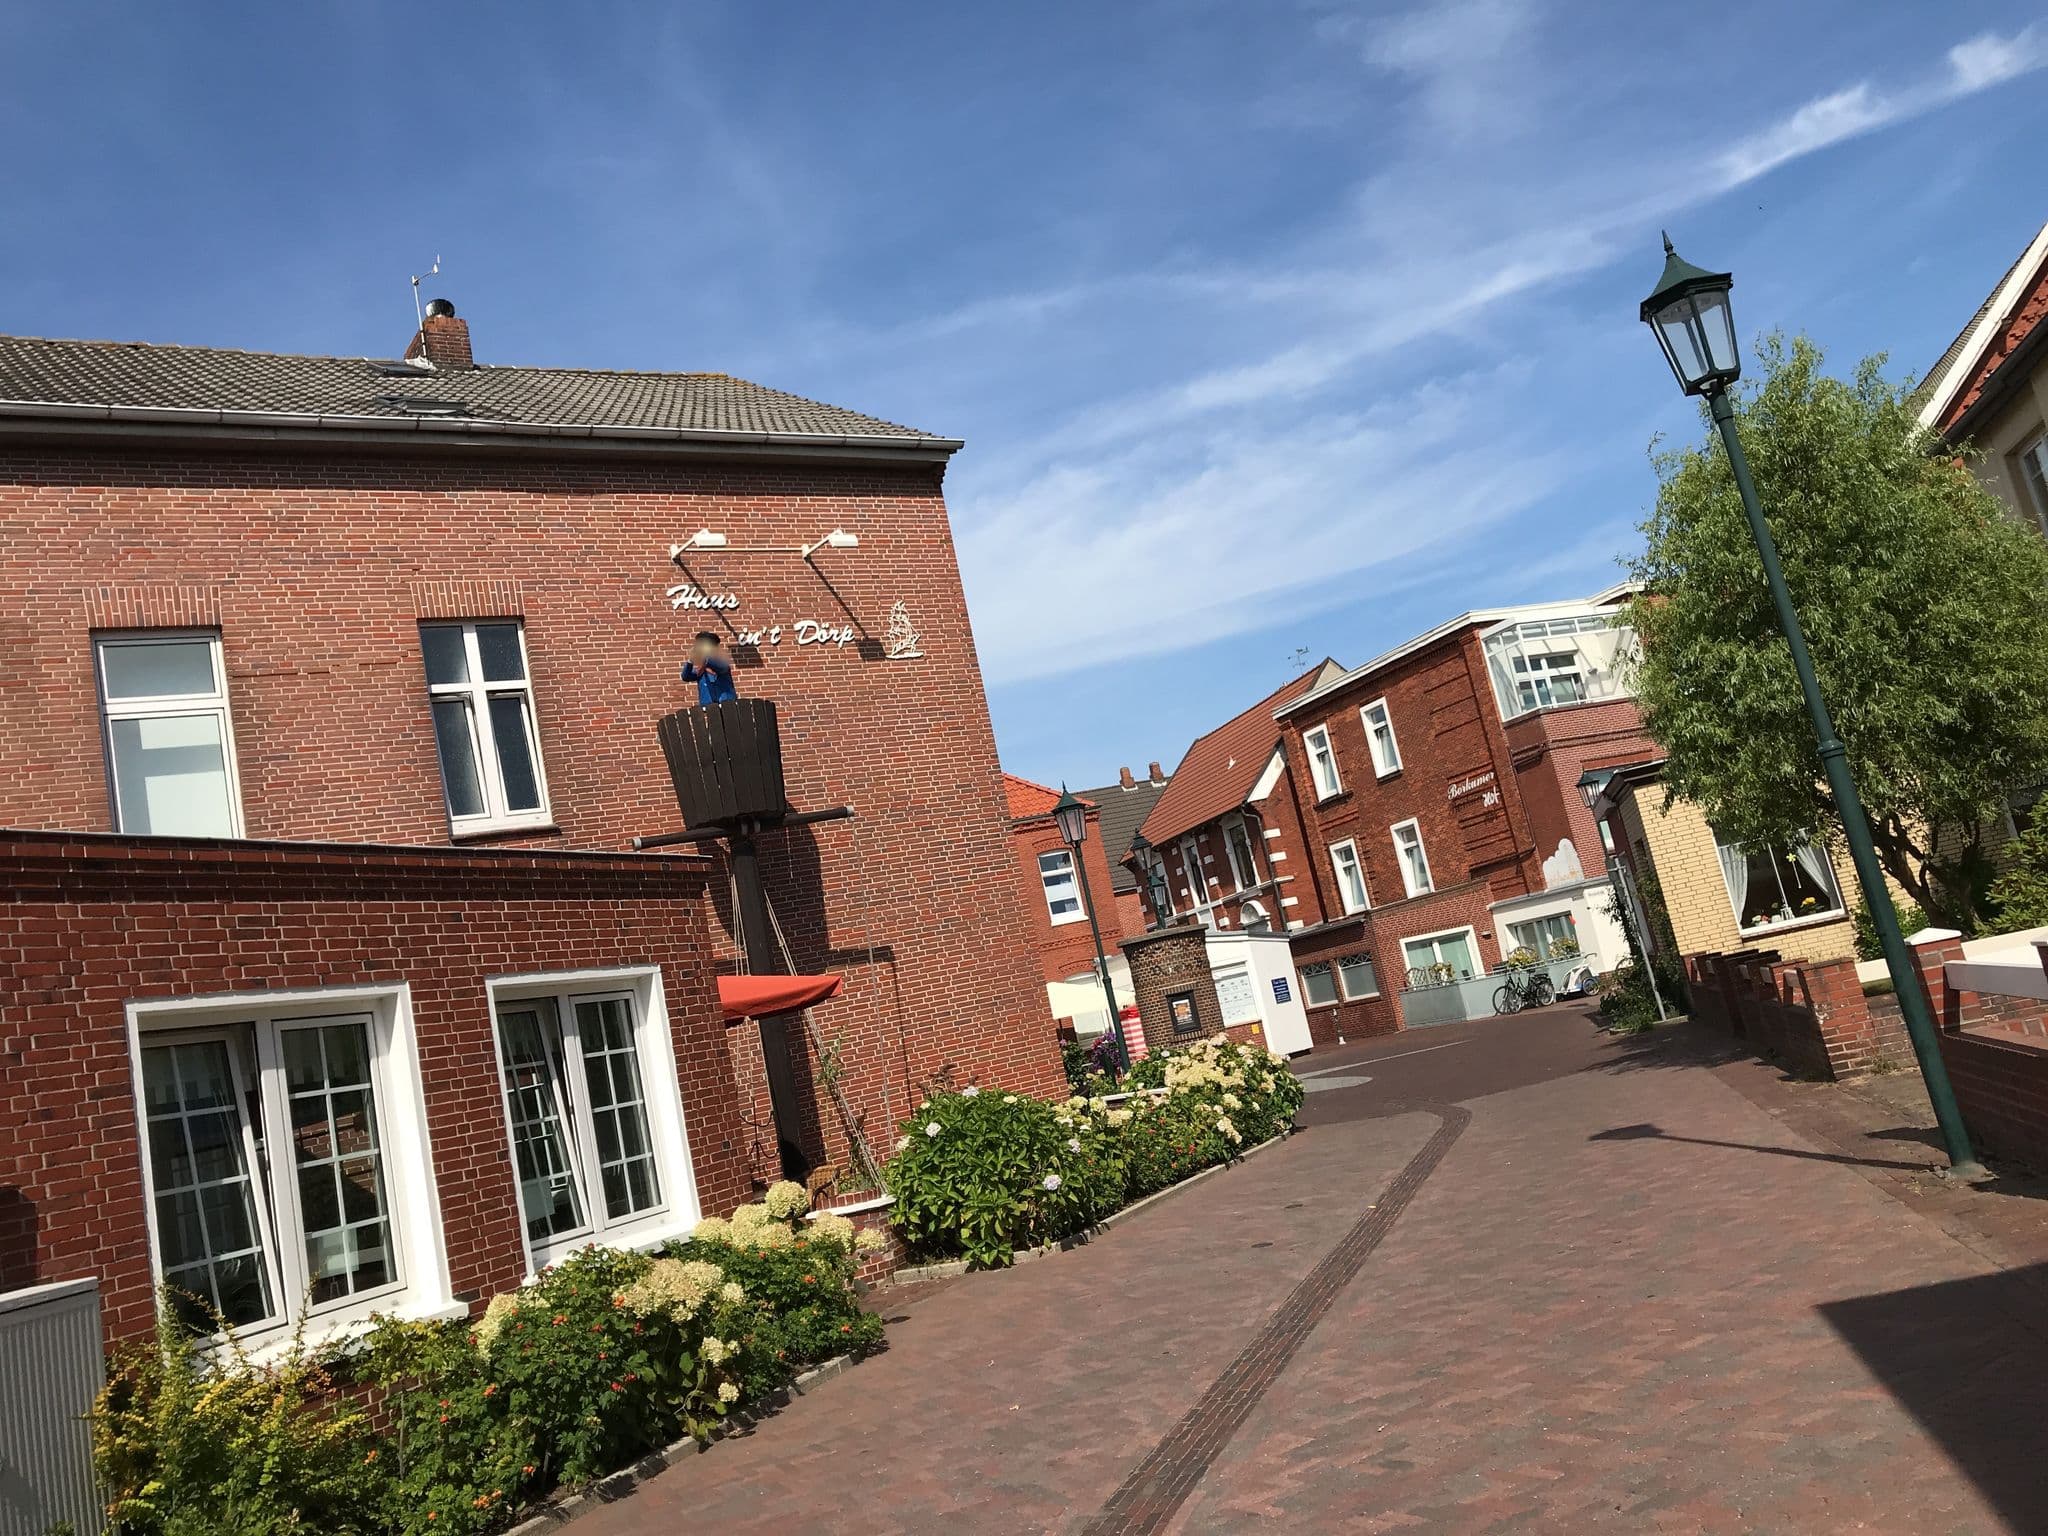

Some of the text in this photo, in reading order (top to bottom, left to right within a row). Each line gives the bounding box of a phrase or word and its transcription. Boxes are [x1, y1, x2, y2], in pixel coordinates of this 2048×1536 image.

[666, 584, 739, 610] Huus
[738, 620, 855, 648] in't Dörp
[1448, 772, 1495, 800] Borkumer
